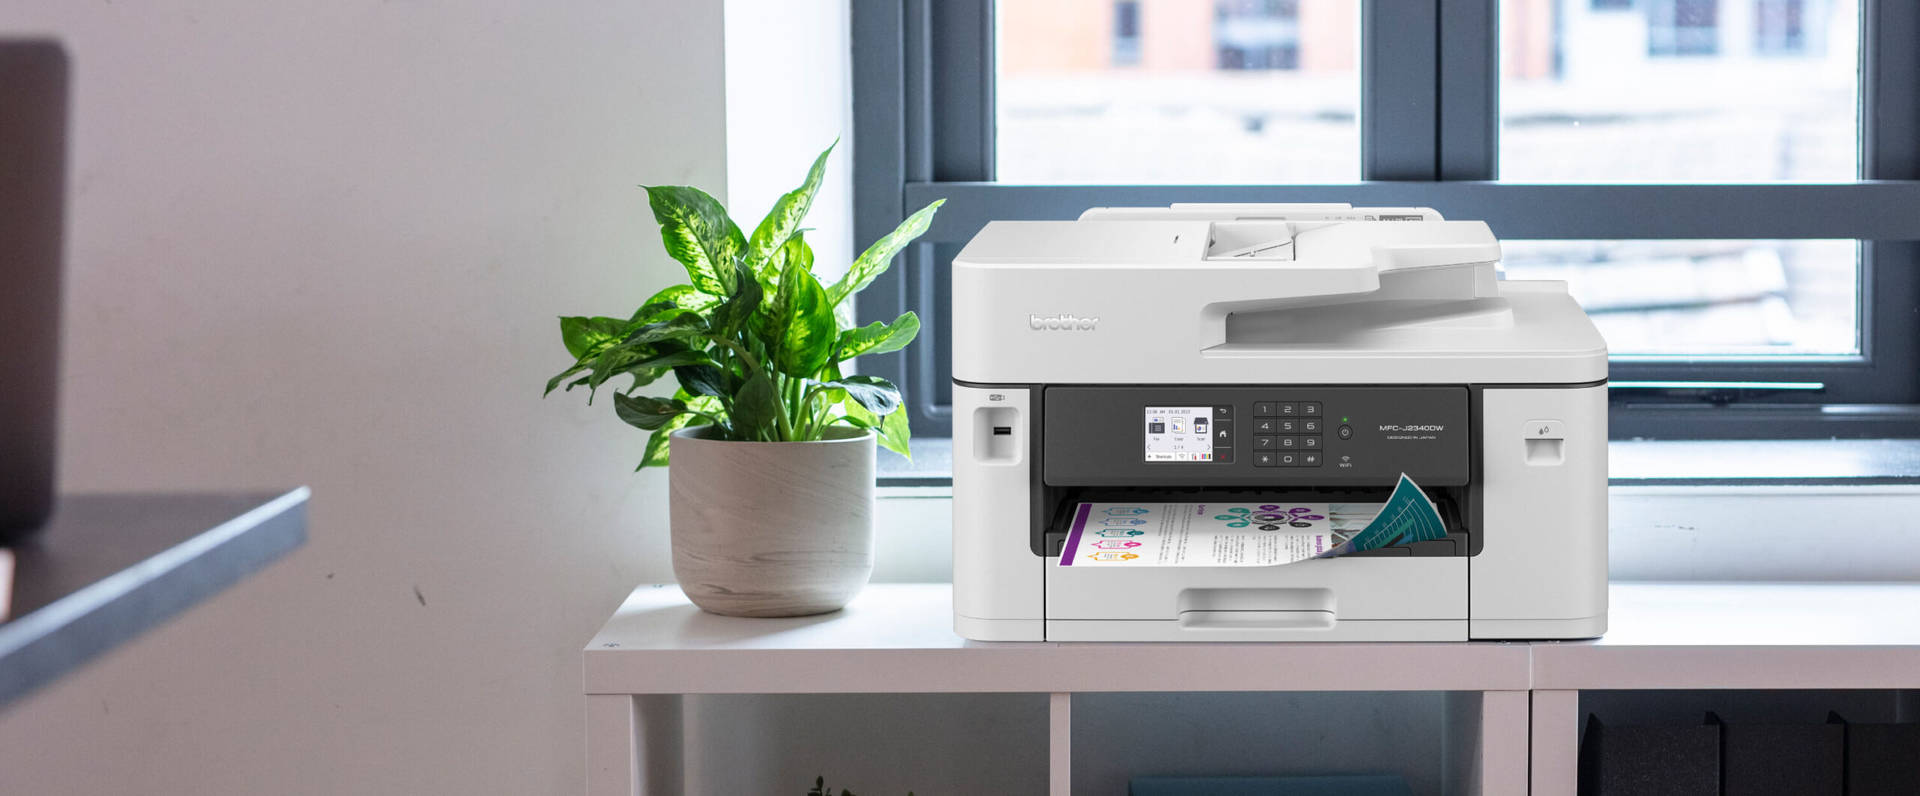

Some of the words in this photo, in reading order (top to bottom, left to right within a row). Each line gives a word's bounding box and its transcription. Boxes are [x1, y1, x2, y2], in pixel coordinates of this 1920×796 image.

[1029, 314, 1099, 331] brother
[1284, 405, 1292, 413] 2
[1307, 405, 1315, 413] 3
[1261, 422, 1269, 430] 4
[1284, 422, 1292, 430] 5
[1306, 422, 1315, 430] 6
